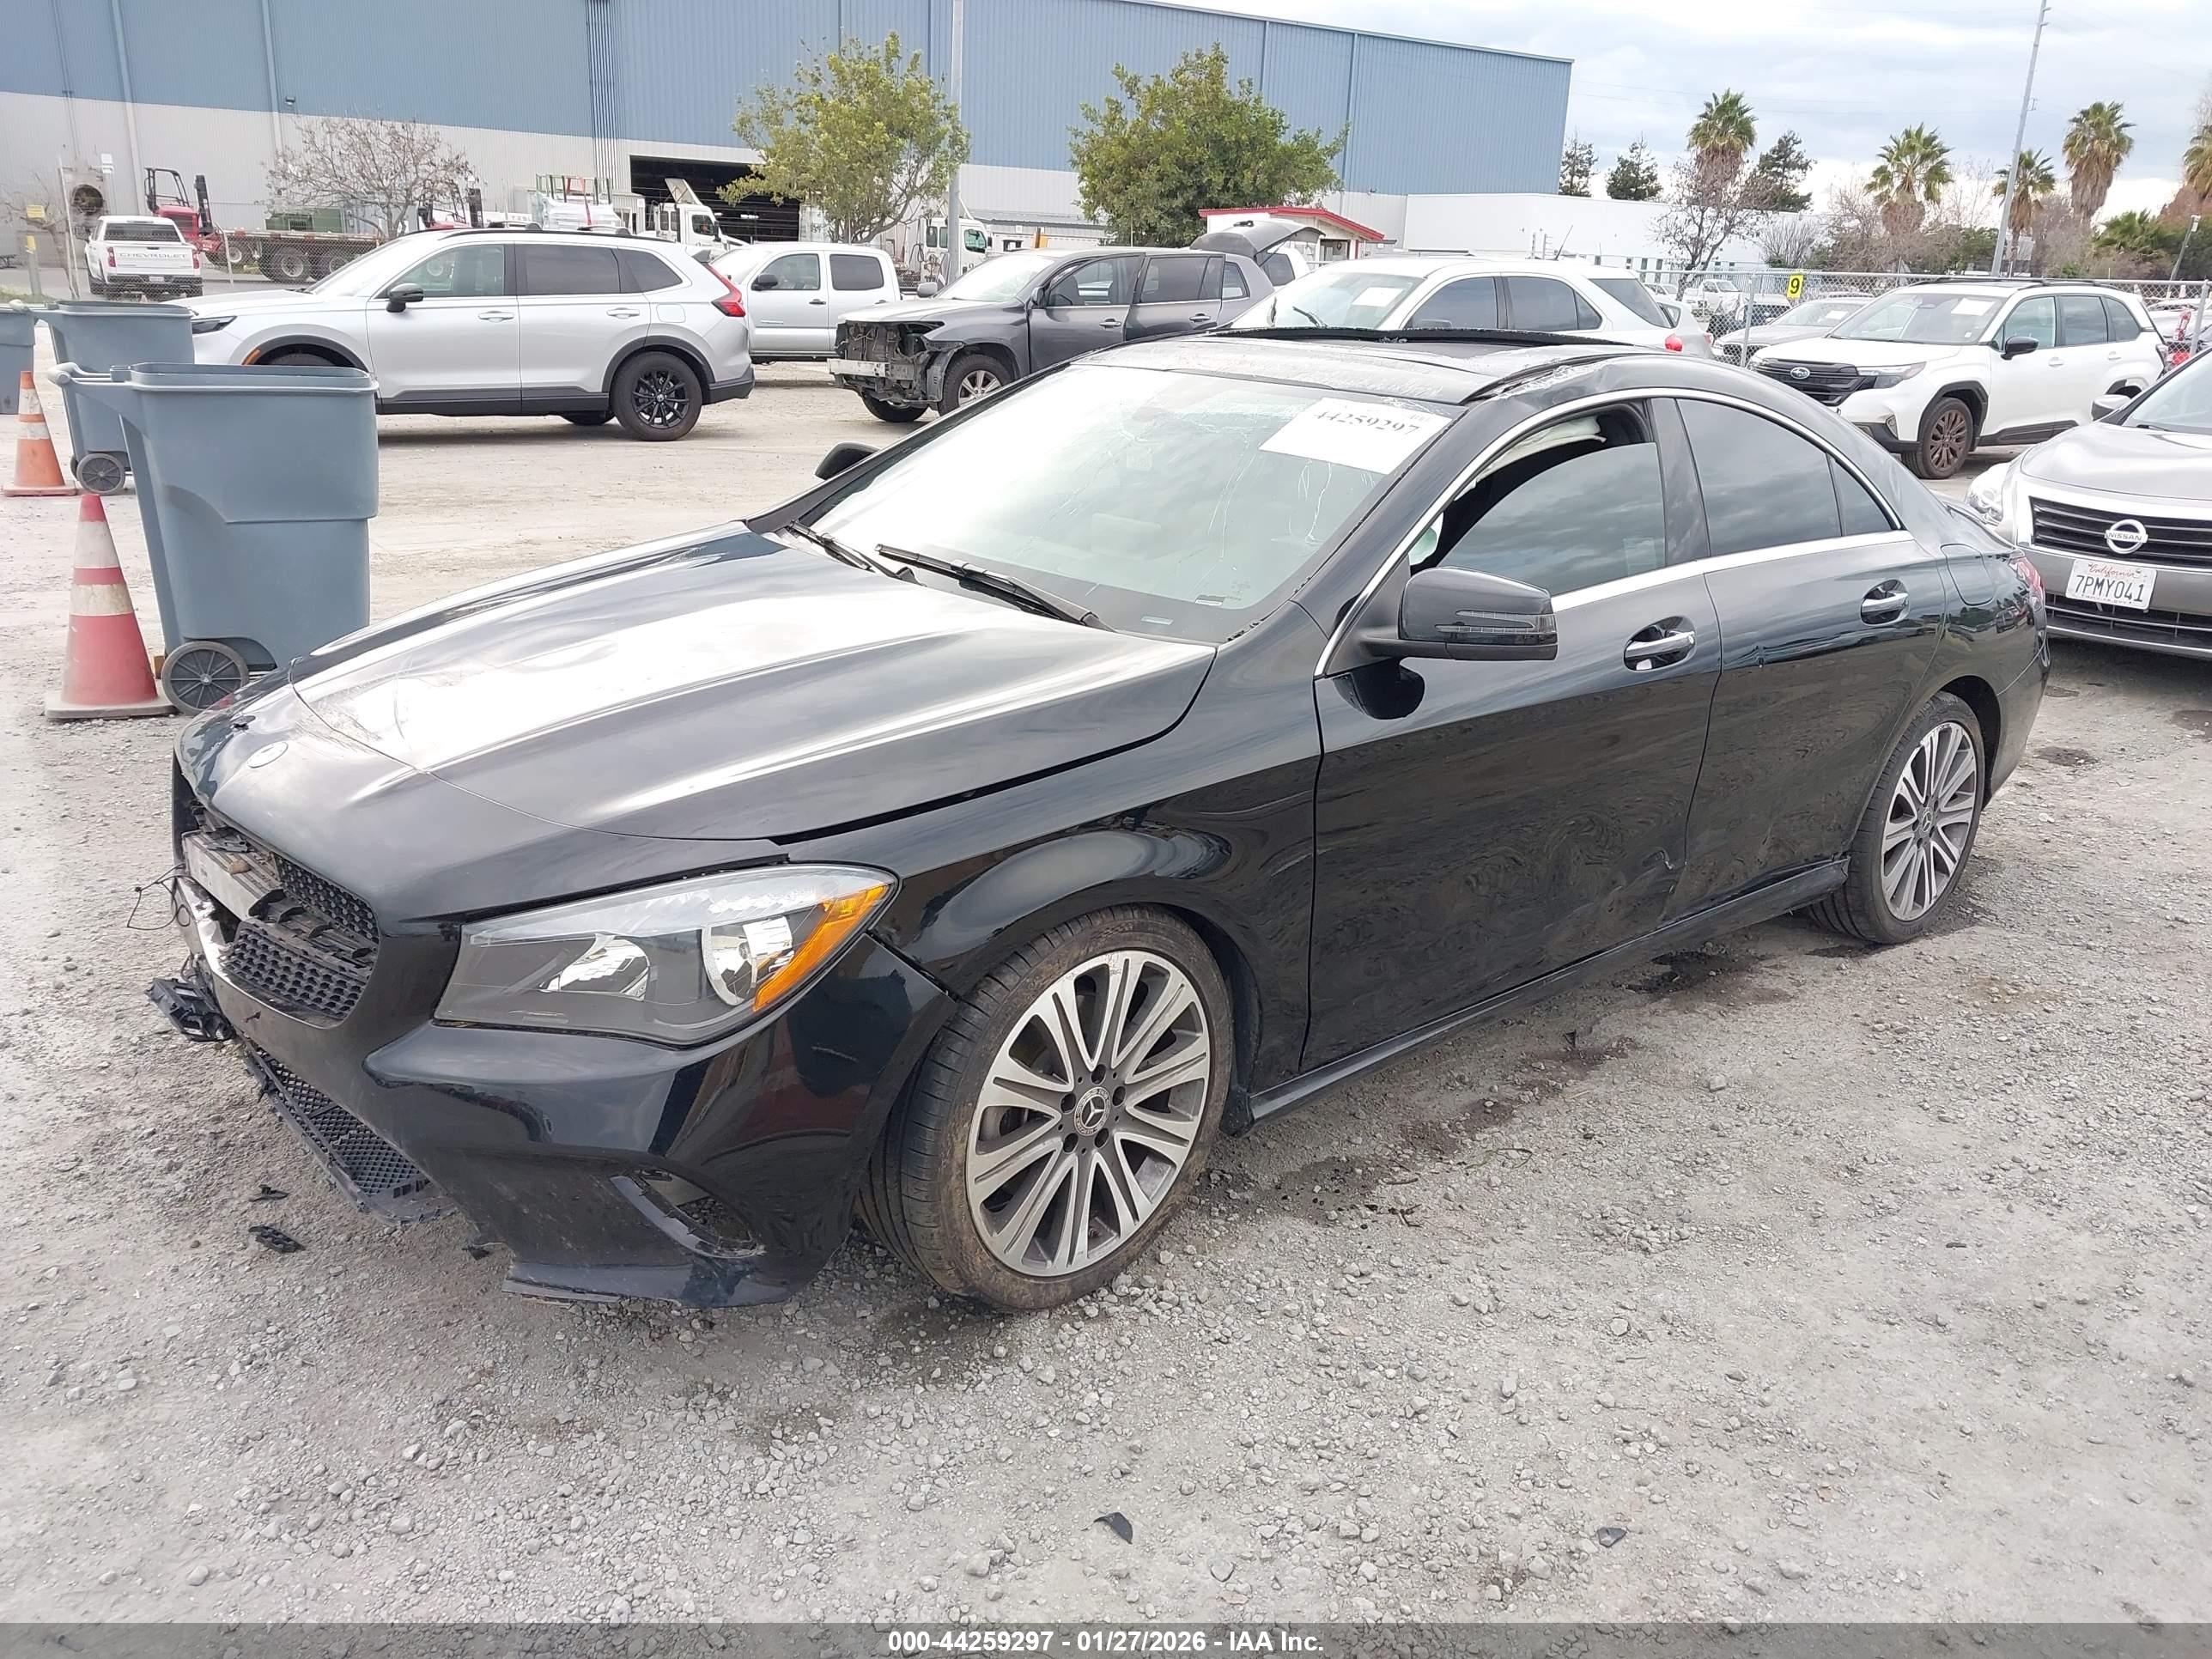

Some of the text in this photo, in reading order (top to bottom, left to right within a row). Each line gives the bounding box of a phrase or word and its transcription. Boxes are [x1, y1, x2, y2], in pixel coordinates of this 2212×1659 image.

[1790, 277, 1800, 295] 9
[1314, 411, 1421, 434] 44259297
[2108, 532, 2142, 541] NISSAN
[2075, 574, 2144, 602] 7PMY041
